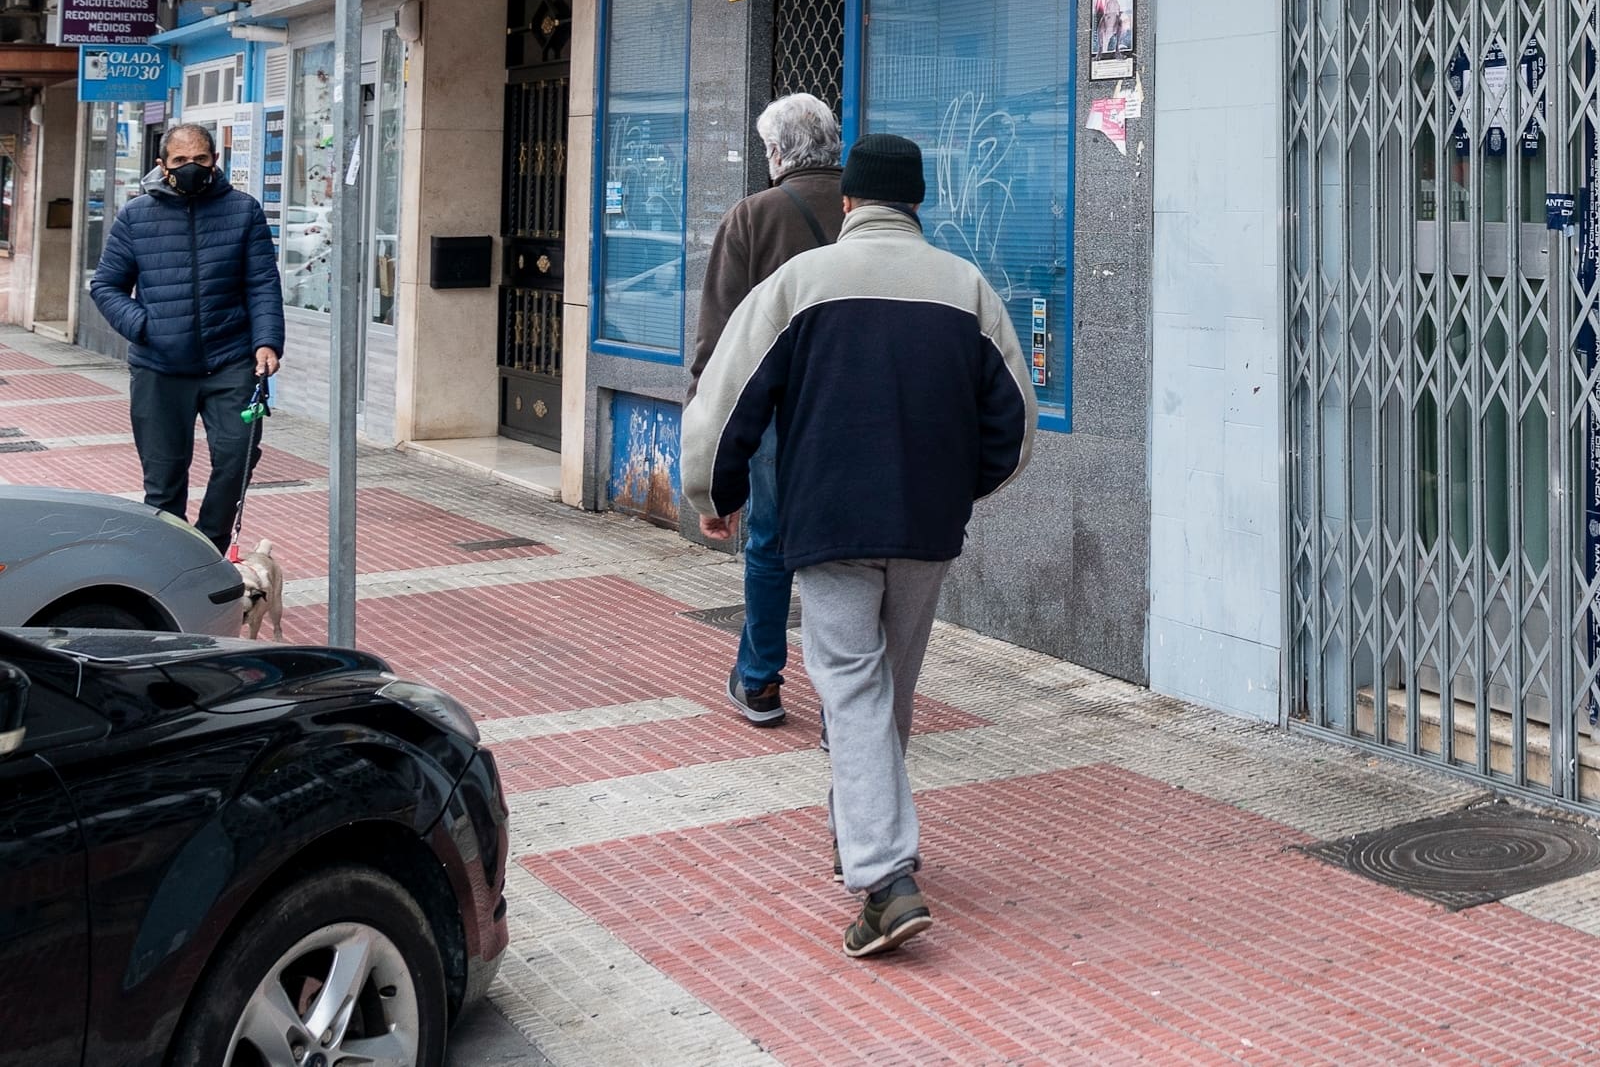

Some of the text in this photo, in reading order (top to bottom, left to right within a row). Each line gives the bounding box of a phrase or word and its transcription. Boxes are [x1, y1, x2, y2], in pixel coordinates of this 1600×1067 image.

[64, 10, 155, 22] RECONOCIMIENTOS
[88, 21, 132, 33] MÉDICOS
[63, 33, 109, 43] PSICOLOGÍA
[115, 36, 147, 44] PEDIATR
[99, 51, 161, 64] COLADA
